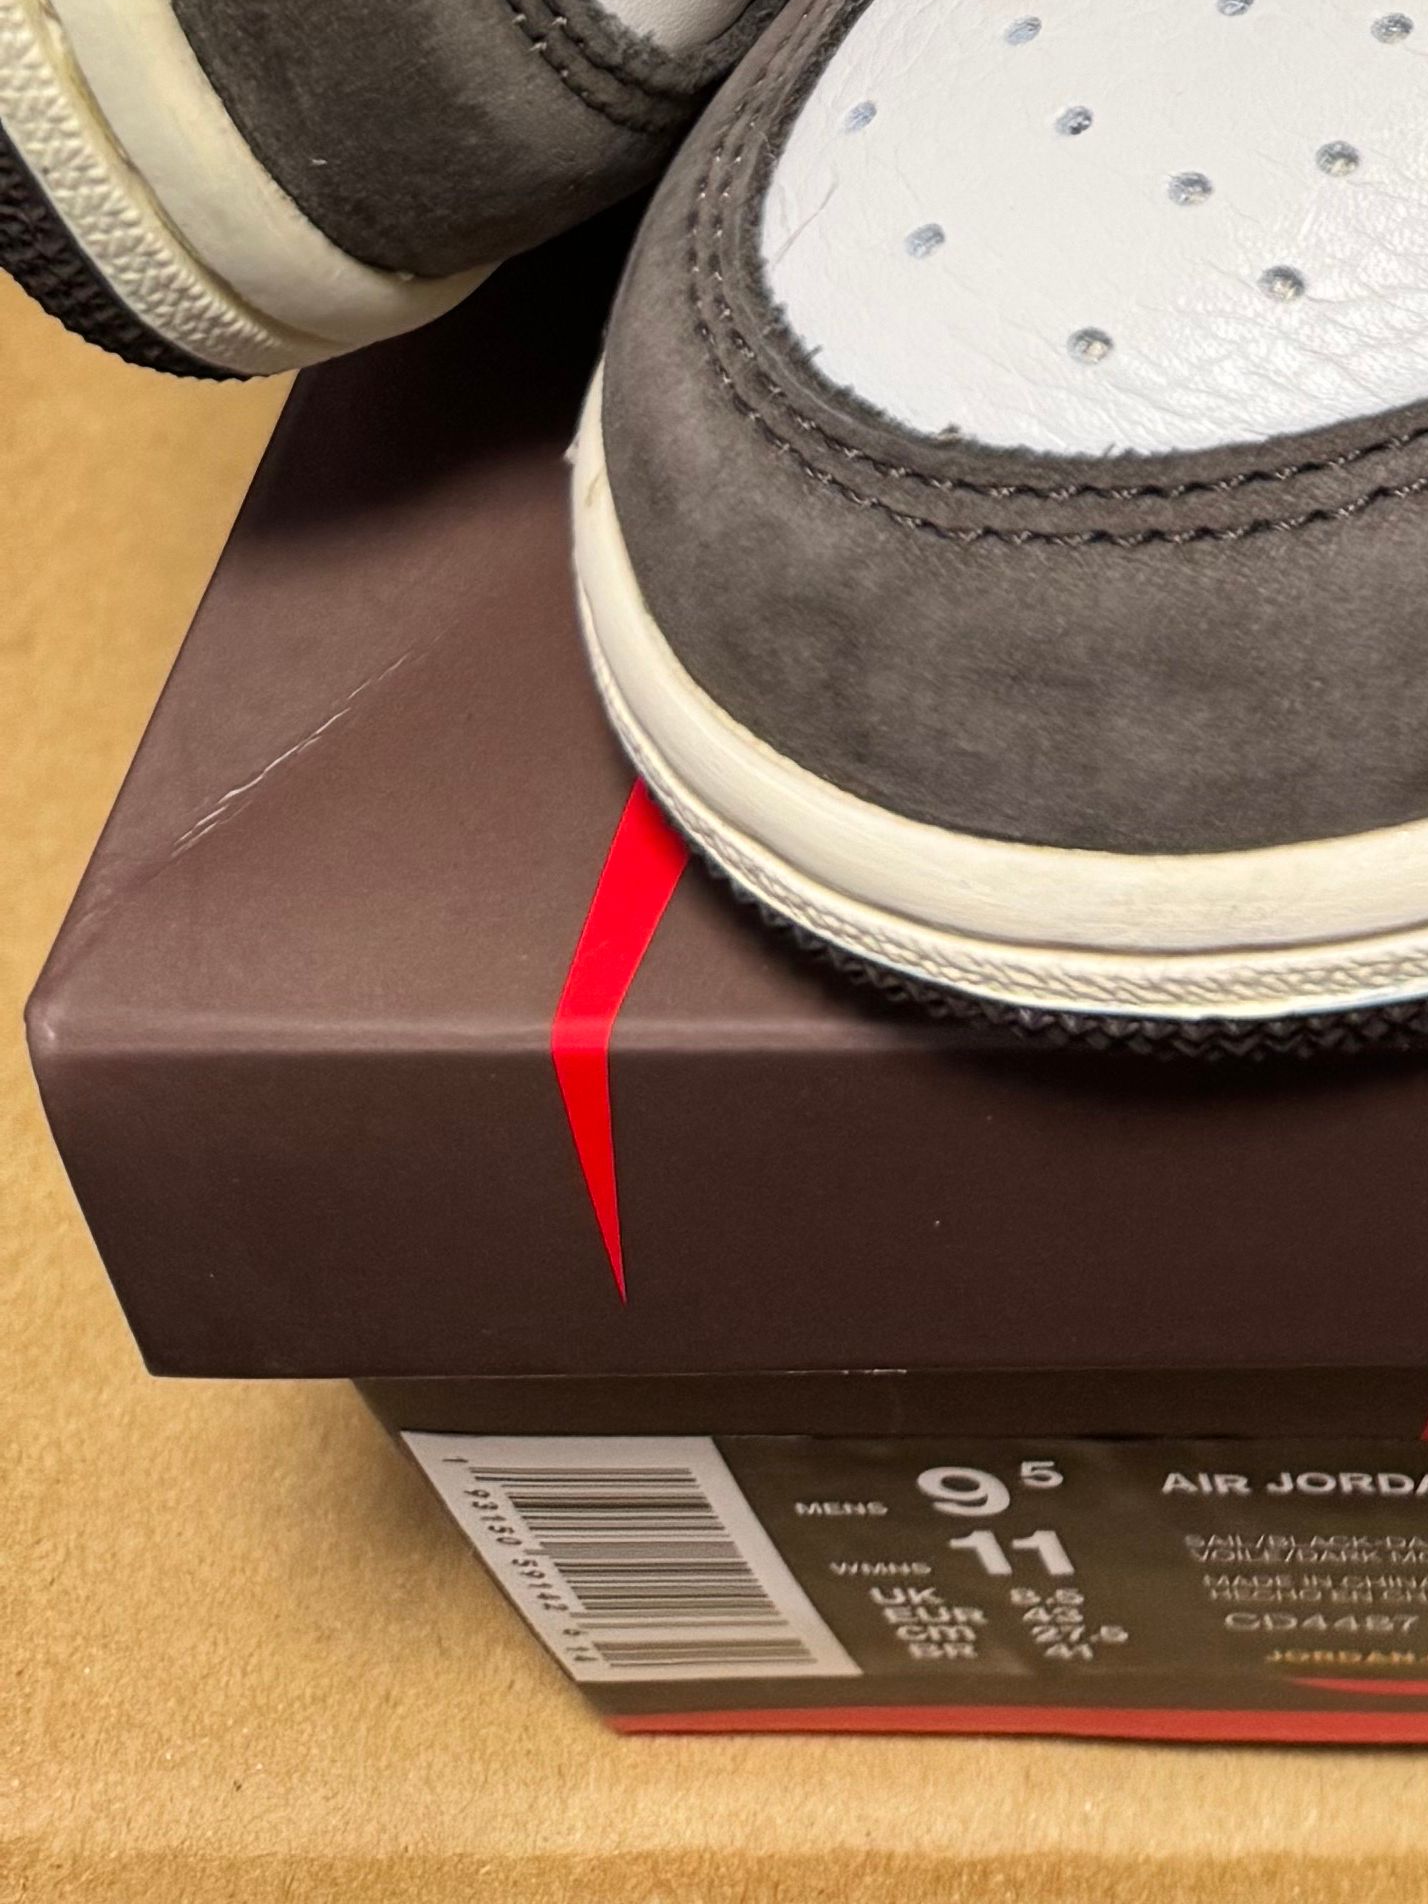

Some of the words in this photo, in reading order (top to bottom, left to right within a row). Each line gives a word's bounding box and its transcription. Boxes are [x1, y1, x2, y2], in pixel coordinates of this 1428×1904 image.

[794, 1501, 888, 1516] MENS
[917, 1466, 1011, 1516] 9
[1160, 1471, 1254, 1496] AIR
[829, 1561, 931, 1577] WMNS
[948, 1530, 1075, 1576] 11
[1203, 1574, 1291, 1589] MADE
[1303, 1574, 1332, 1589] IN
[870, 1587, 944, 1607] UK
[1010, 1588, 1084, 1608] 8.5
[883, 1607, 988, 1624] EUR
[1023, 1607, 1084, 1624] 43
[1224, 1613, 1420, 1632] CD4487
[908, 1643, 977, 1660] BR
